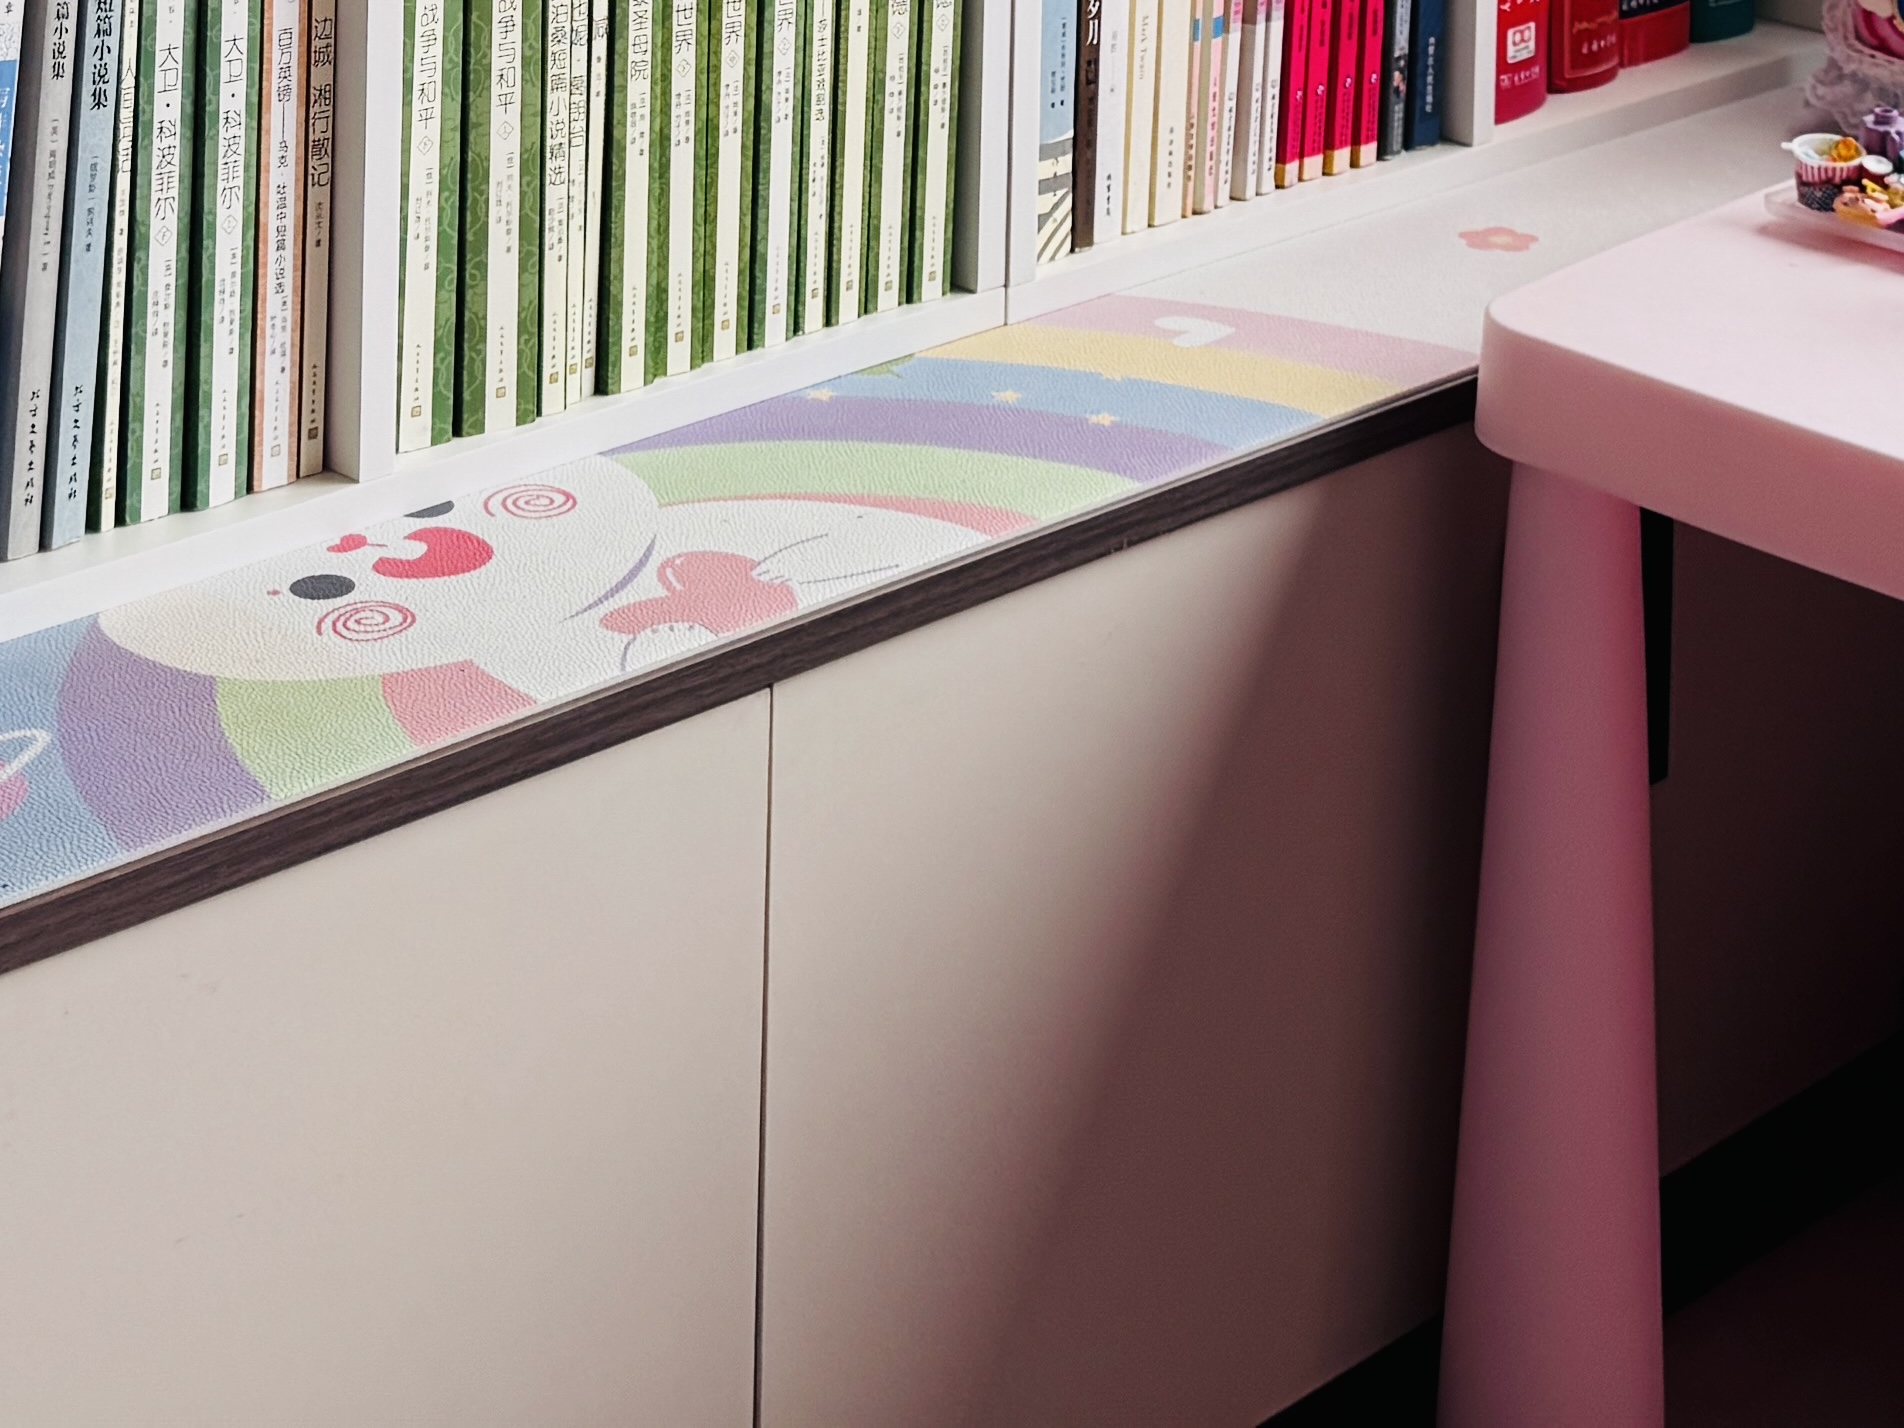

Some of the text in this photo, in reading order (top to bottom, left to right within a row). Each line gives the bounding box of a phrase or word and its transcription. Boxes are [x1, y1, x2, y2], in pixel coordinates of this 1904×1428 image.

[310, 17, 332, 188] 边城 湘行散记
[416, 3, 439, 131] 战争与和平
